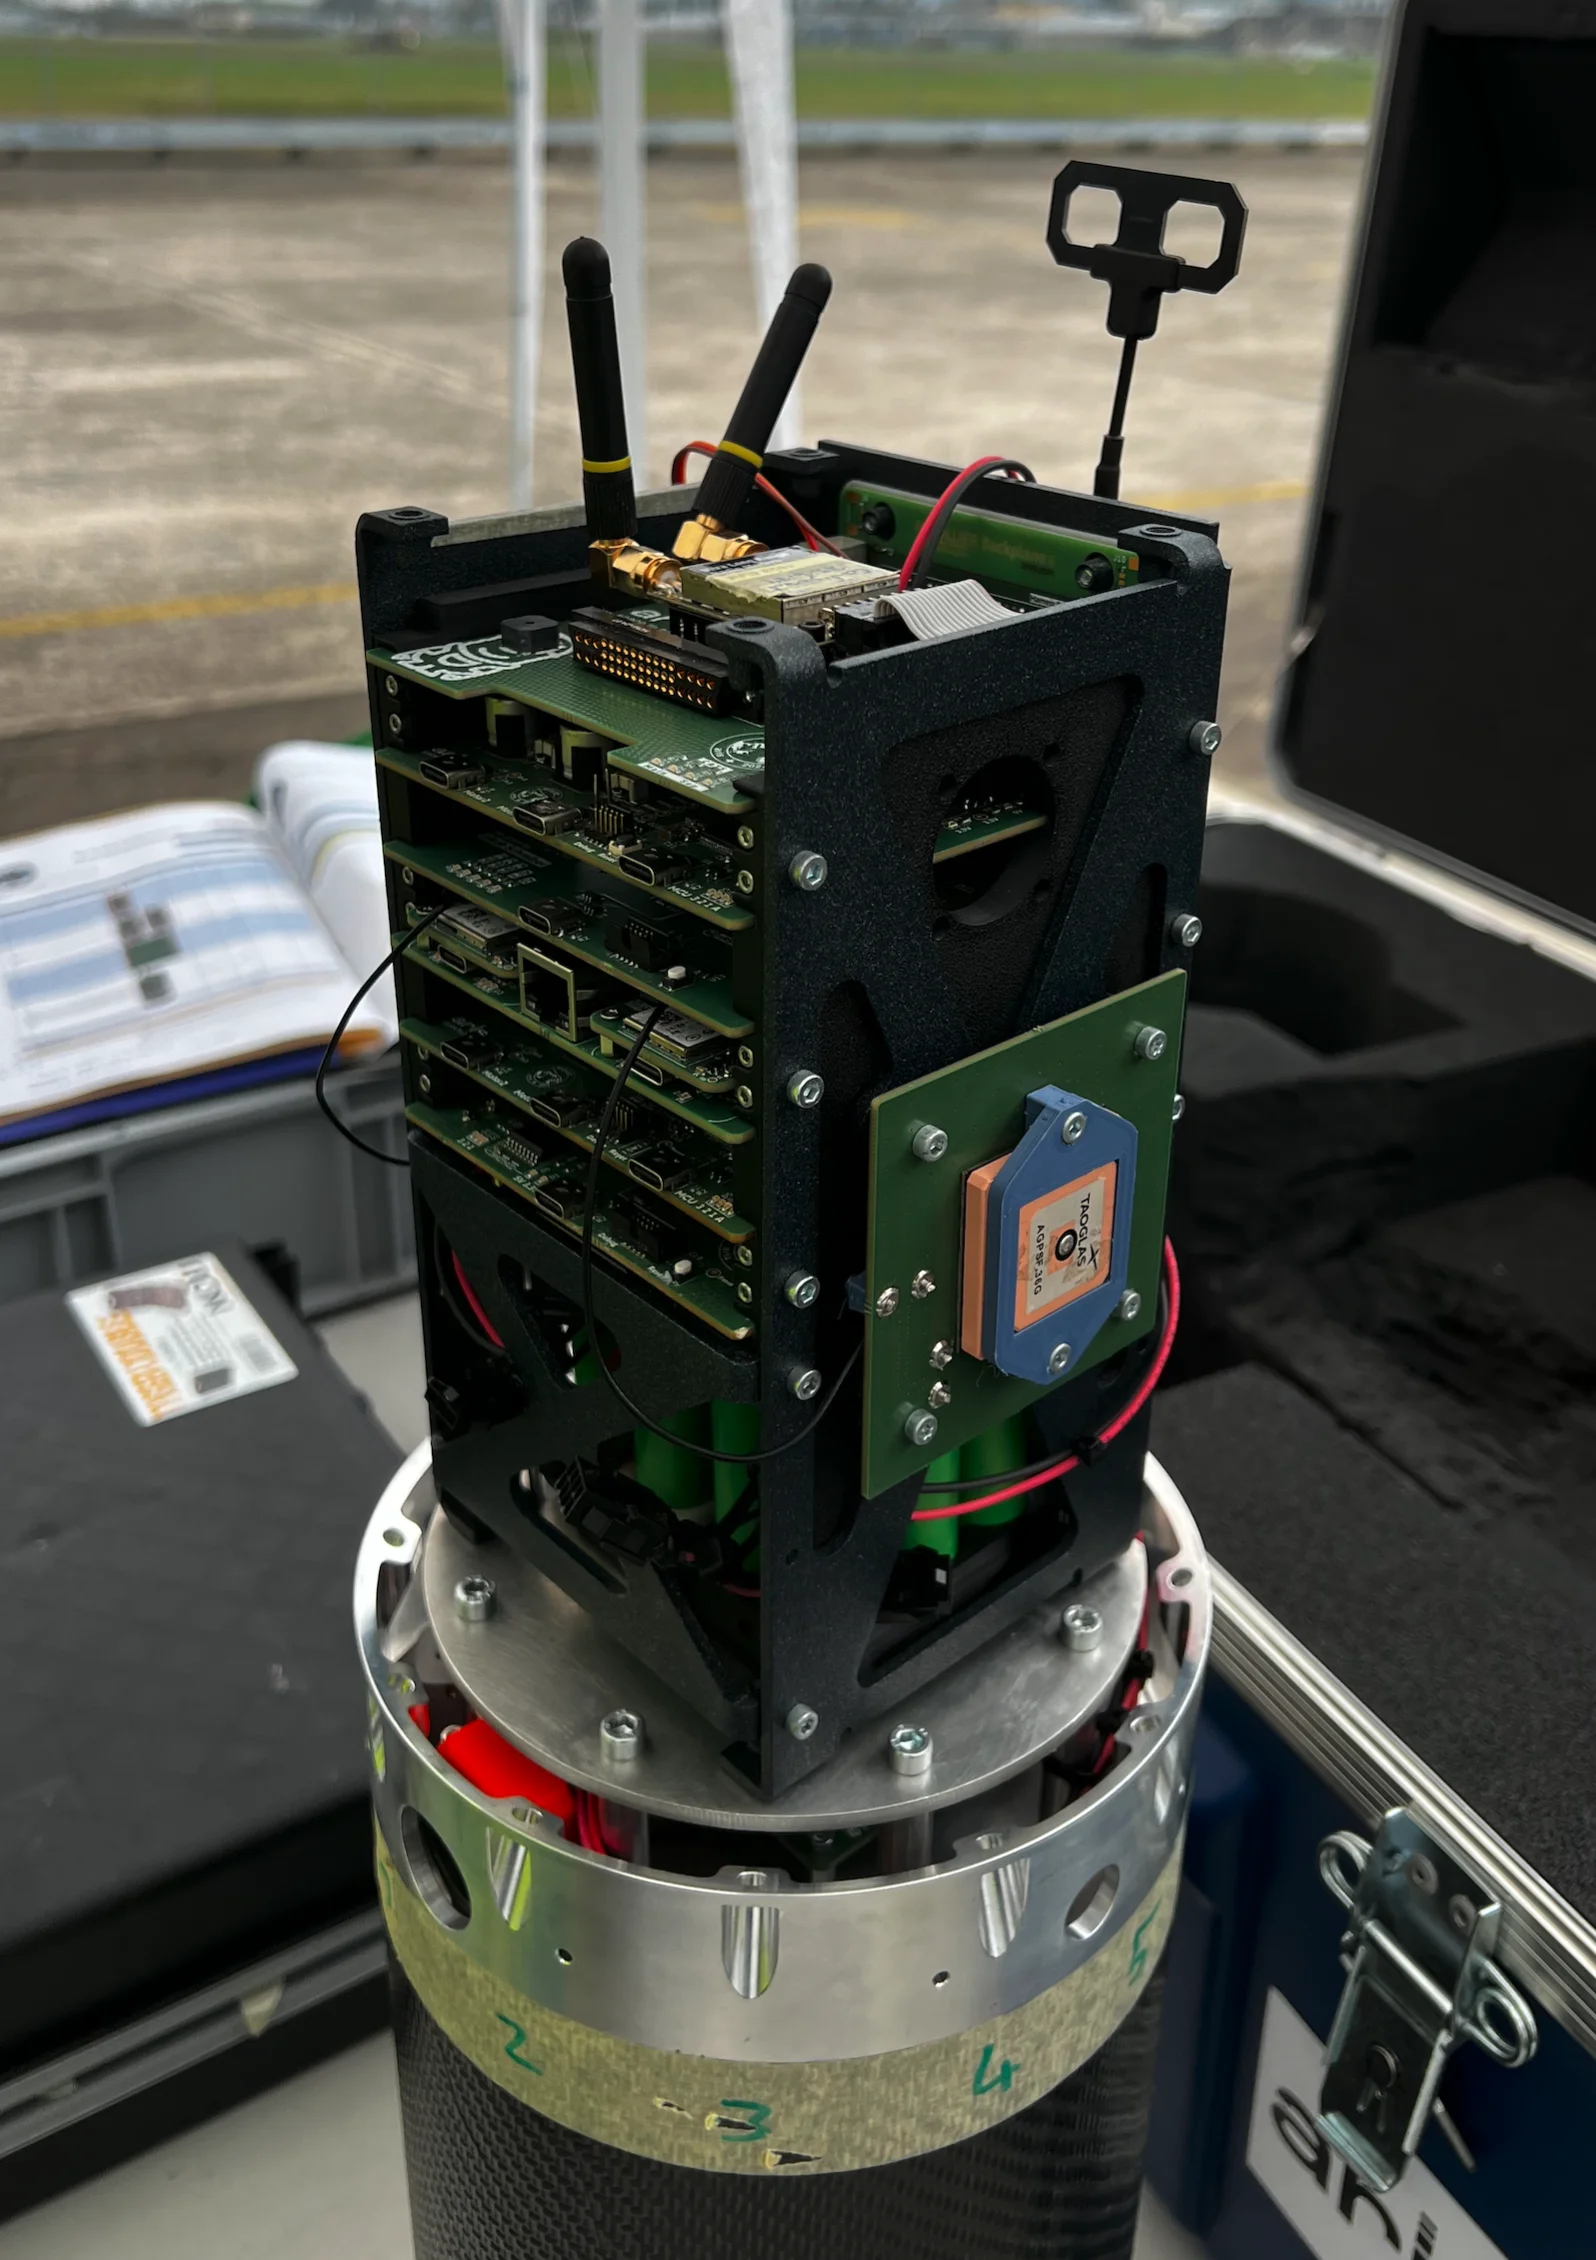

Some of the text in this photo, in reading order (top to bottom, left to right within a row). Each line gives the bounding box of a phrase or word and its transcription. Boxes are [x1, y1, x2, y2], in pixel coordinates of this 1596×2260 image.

[1077, 1192, 1090, 1267] TAOGLAS
[494, 2011, 544, 2077] 2
[972, 2042, 1021, 2096] 4
[720, 2098, 773, 2142] 3
